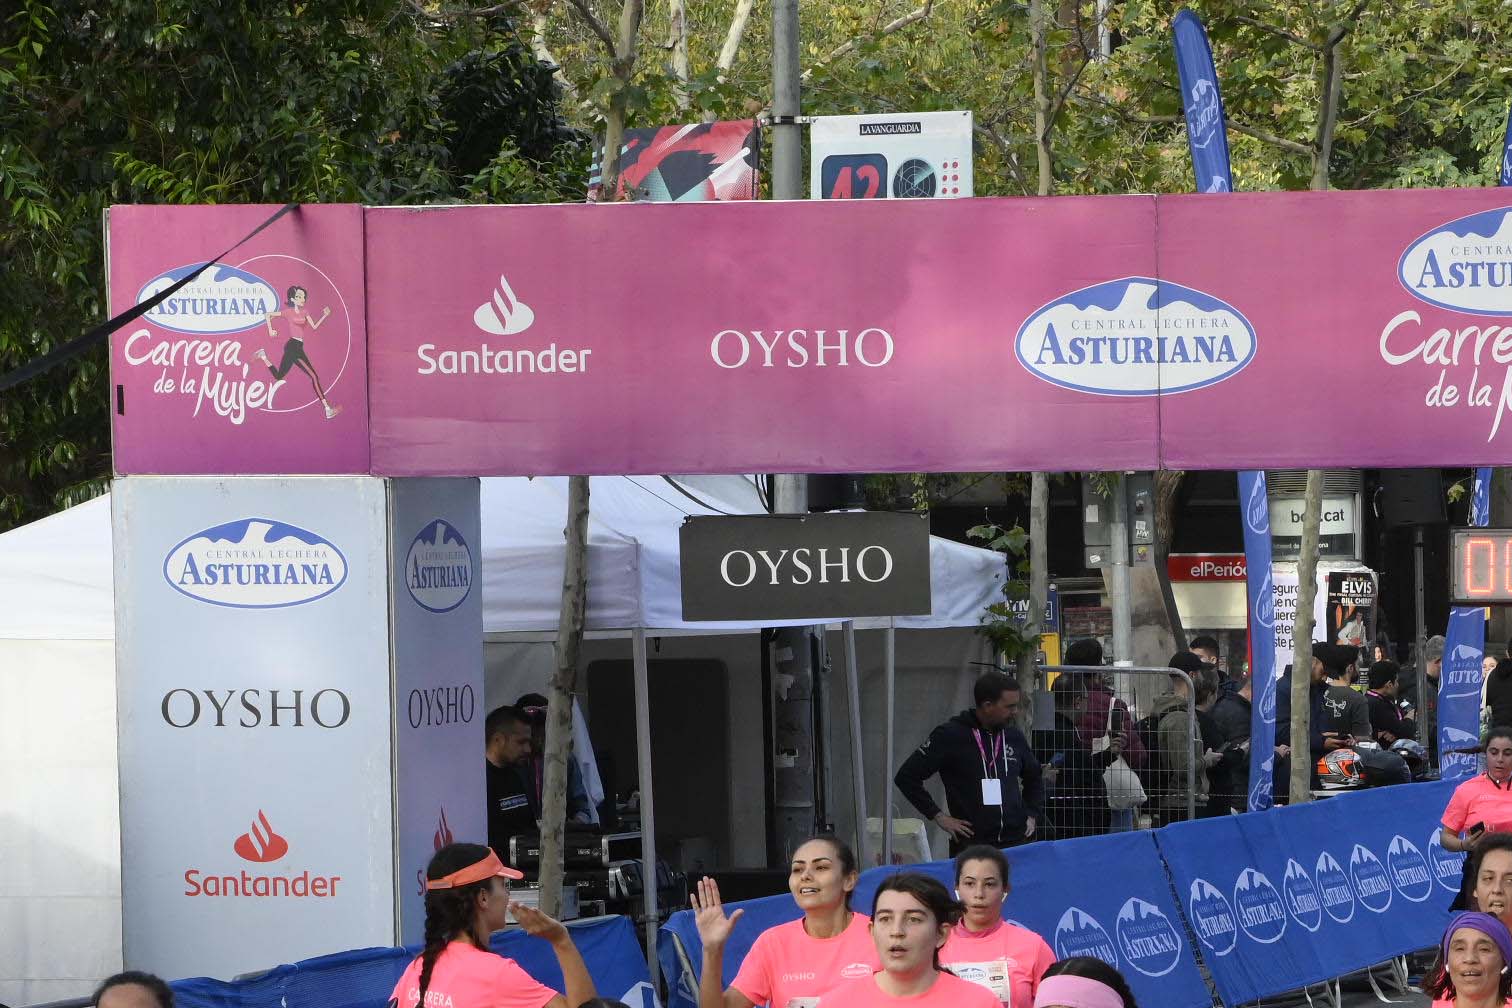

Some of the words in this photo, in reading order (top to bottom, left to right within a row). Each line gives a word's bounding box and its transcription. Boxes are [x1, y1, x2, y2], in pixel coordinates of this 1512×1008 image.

[177, 287, 215, 295] ENTRAL
[218, 286, 264, 295] LECHERA
[1071, 318, 1145, 329] CENTRAL
[1153, 317, 1230, 329] LECHERA
[124, 328, 242, 367] Carrera
[417, 342, 592, 375] Santander
[711, 327, 895, 369] OYSHO
[1034, 322, 1238, 366] ASTURIANA
[153, 368, 175, 394] de
[181, 368, 196, 394] la
[194, 363, 287, 425] Mujer
[1425, 369, 1461, 406] de
[1468, 368, 1493, 406] la
[178, 552, 334, 586] ASTURIANA
[206, 551, 264, 559] CENTRAL
[270, 550, 328, 559] LECHERA
[720, 545, 894, 588] OYSHO
[411, 556, 469, 591] ASTURIANA
[1341, 581, 1373, 594] ELVIS
[1273, 637, 1287, 648] ste
[161, 688, 351, 729] OYSHO
[408, 684, 474, 729] OYSHO
[184, 870, 341, 898] Santander
[408, 987, 454, 1008] CARERA
